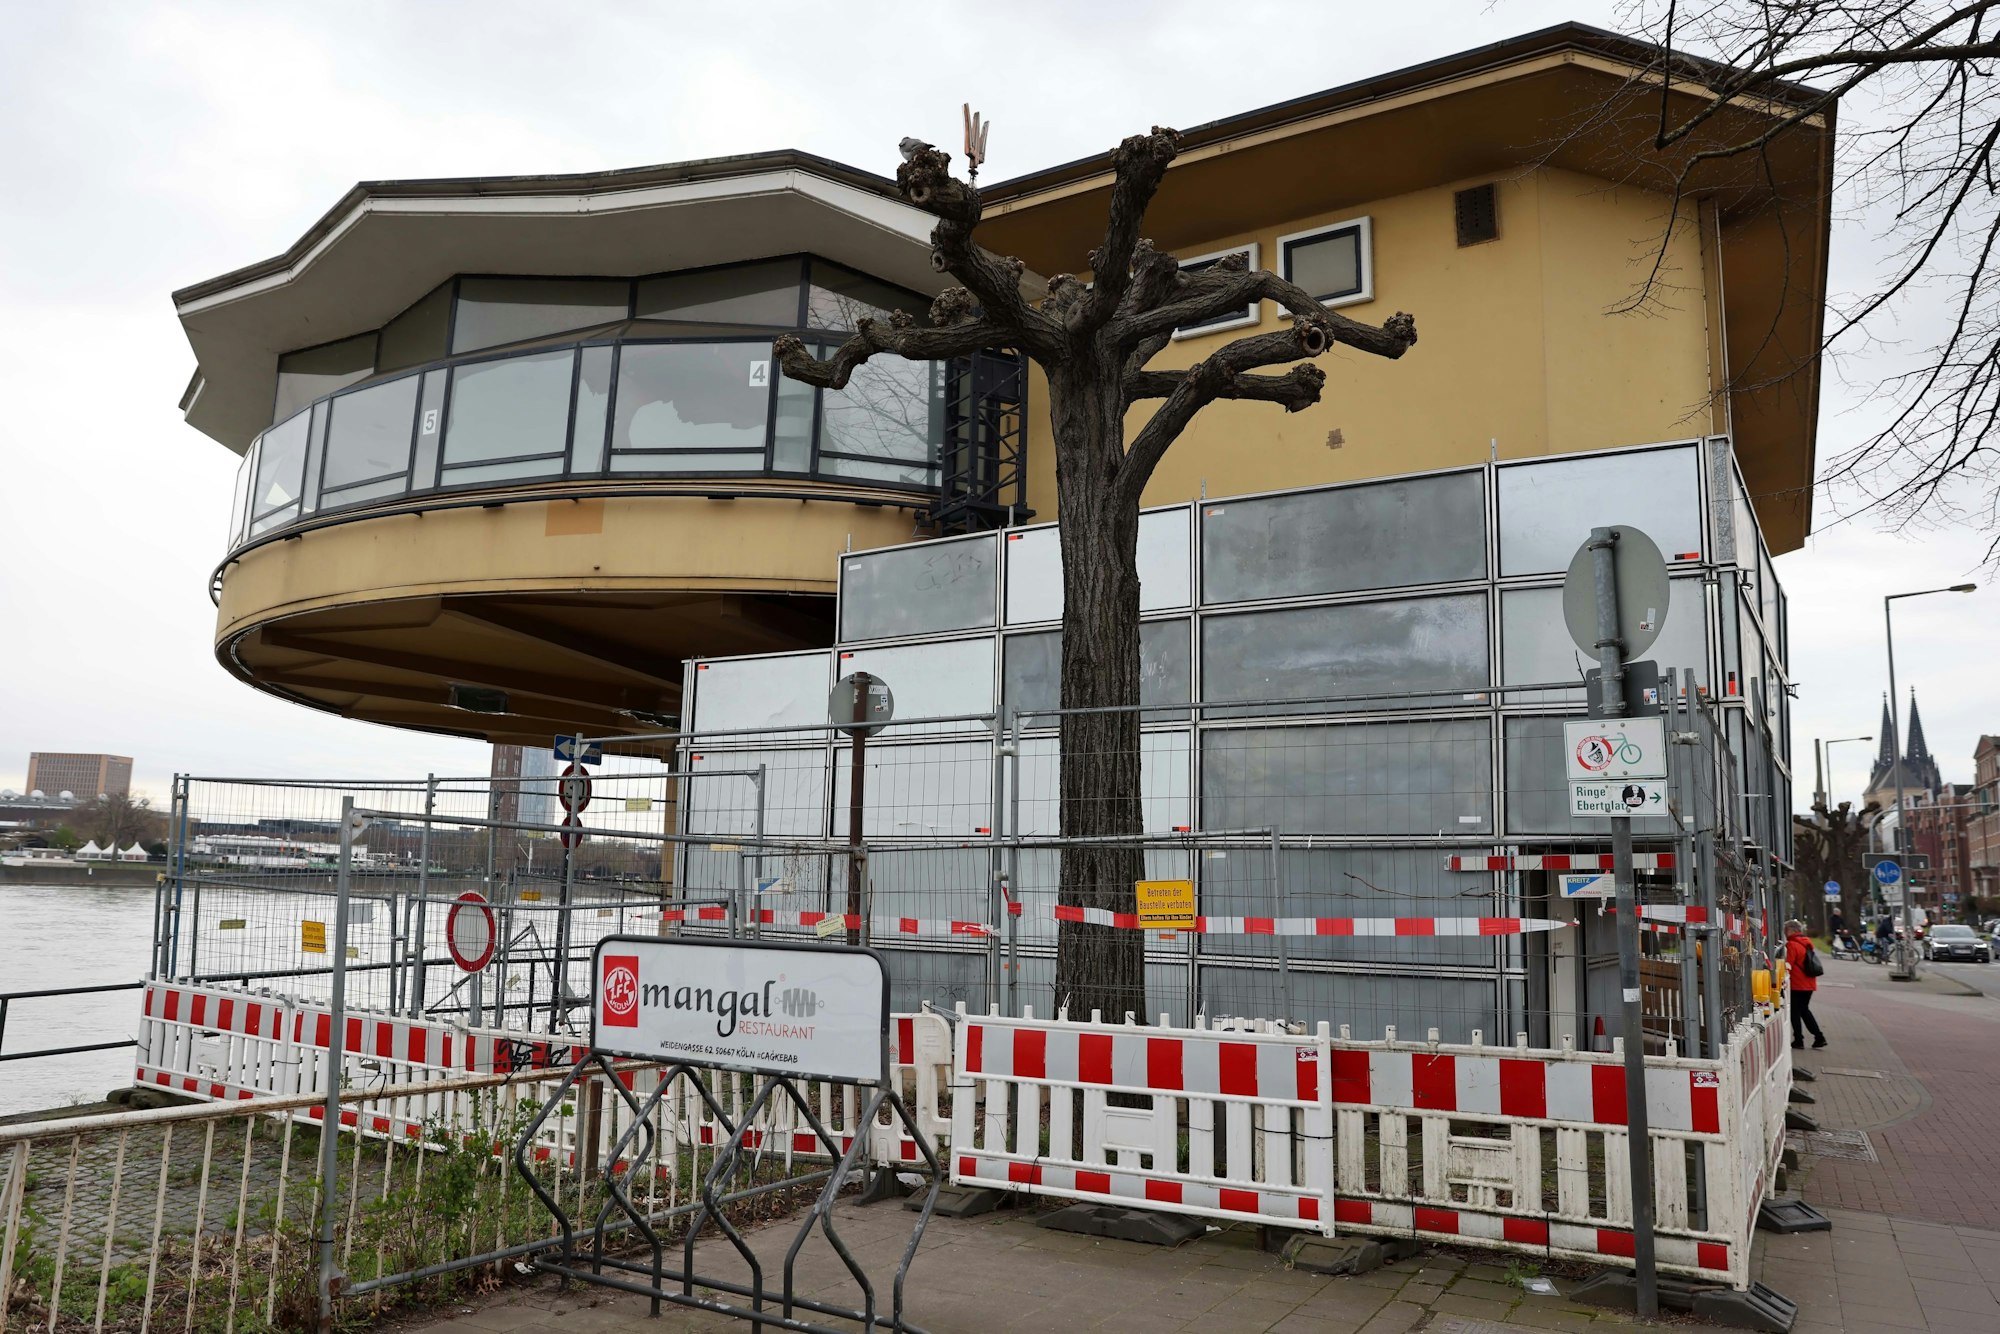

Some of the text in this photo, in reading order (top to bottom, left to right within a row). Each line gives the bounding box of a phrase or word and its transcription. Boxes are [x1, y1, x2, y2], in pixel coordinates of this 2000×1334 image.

[752, 363, 765, 382] 4
[425, 413, 435, 431] 5
[1576, 786, 1606, 799] Ringe
[1577, 800, 1629, 813] Ebertplat
[1147, 888, 1182, 897] Betreten der
[1139, 900, 1192, 909] Baustelle verboten
[641, 980, 776, 1038] mangal
[739, 1020, 815, 1040] RESTAURANT
[660, 1040, 704, 1053] WEIDENGASSE
[715, 1046, 735, 1057] 50667
[736, 1046, 755, 1059] KÖLN
